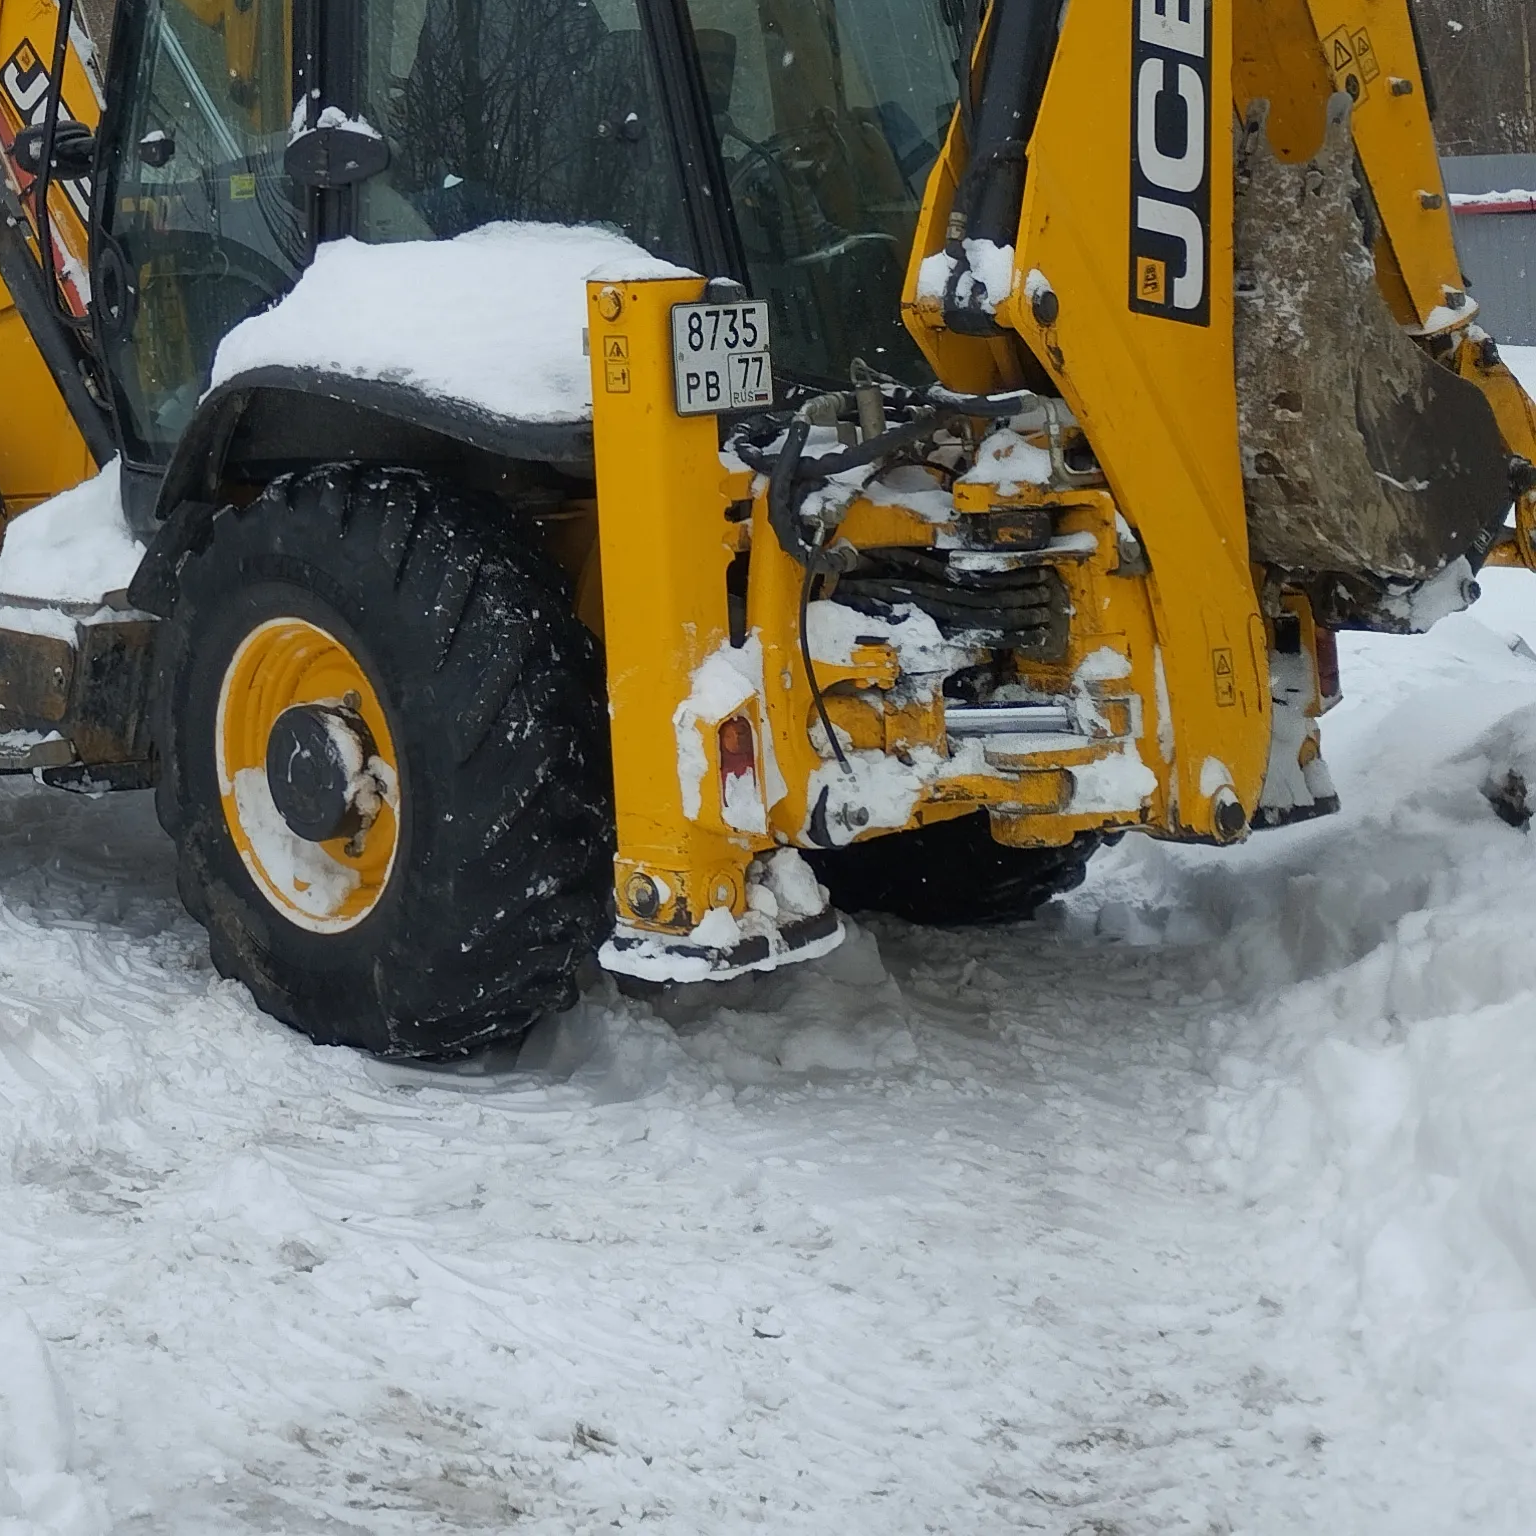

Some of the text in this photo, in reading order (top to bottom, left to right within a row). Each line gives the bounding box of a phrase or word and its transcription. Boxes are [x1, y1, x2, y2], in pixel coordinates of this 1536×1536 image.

[1143, 264, 1159, 290] JCB
[687, 307, 758, 352] 8735
[686, 370, 721, 405] PB
[737, 356, 763, 390] 77
[733, 390, 755, 404] RUS
